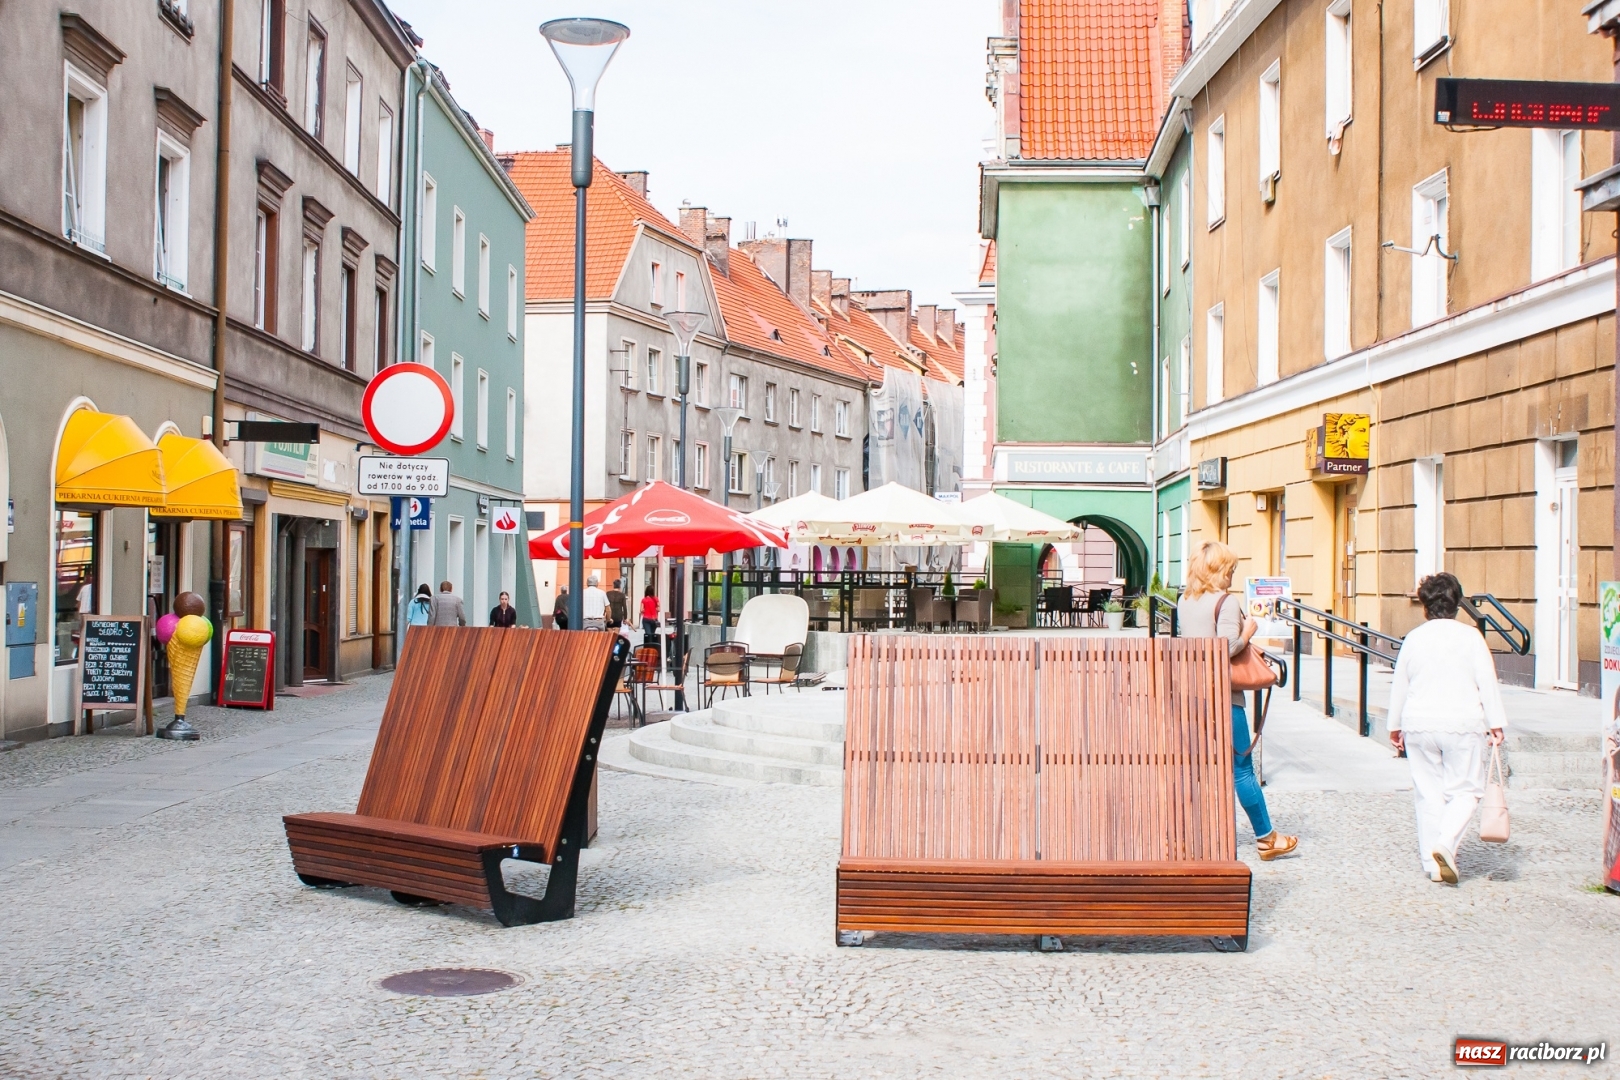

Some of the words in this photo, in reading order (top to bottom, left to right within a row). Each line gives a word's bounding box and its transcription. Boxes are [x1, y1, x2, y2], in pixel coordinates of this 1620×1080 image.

[379, 462, 393, 470] Nie
[396, 462, 429, 472] dotyczy
[1014, 460, 1093, 474] RISTORANTE
[1096, 461, 1105, 474] &
[1108, 461, 1140, 474] CAFE
[1327, 461, 1363, 472] Partner
[381, 482, 402, 490] 17.00
[405, 483, 416, 491] do
[420, 483, 439, 491] 9.00
[58, 492, 101, 501] PIEKARNIA
[102, 493, 141, 502] CUKIERNIA
[152, 506, 188, 514] PIEKARNIA
[189, 507, 222, 515] CUKIERNIA
[395, 518, 427, 526] Mnetia
